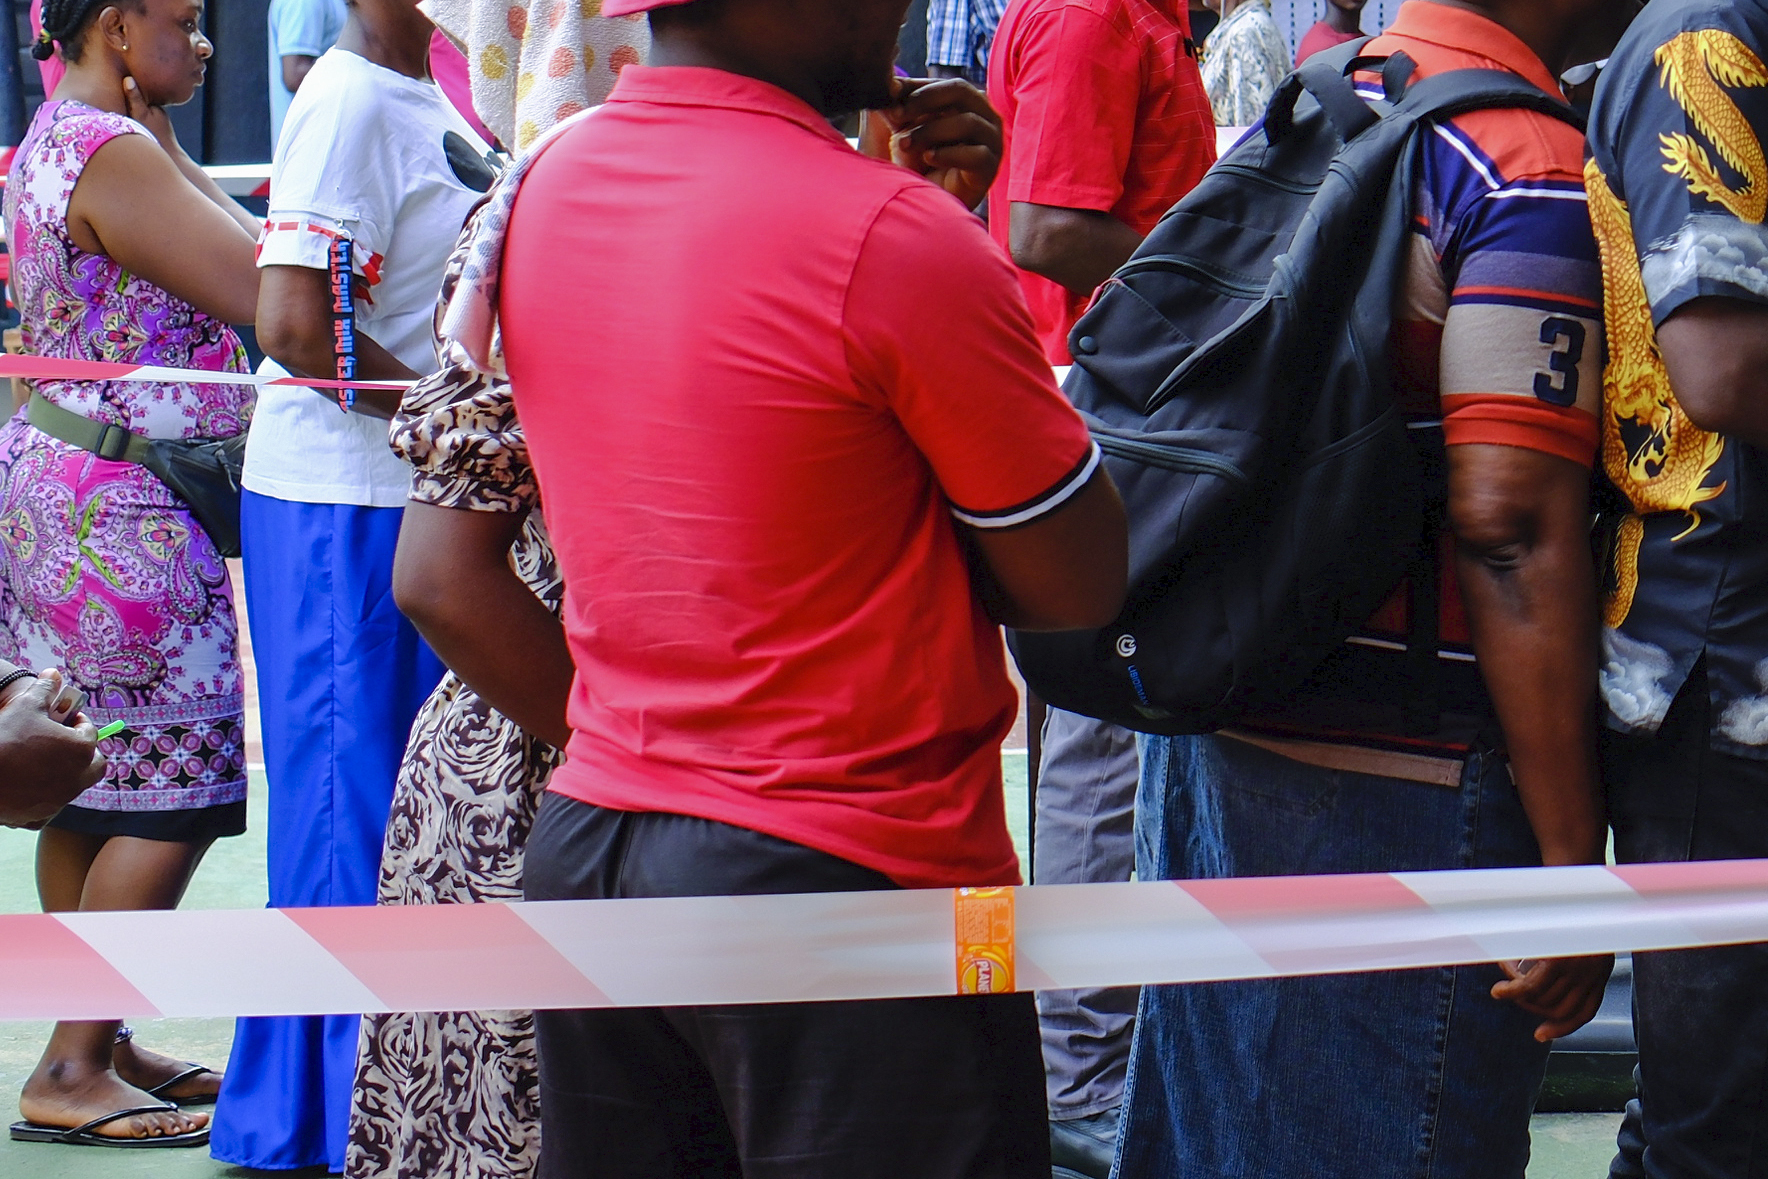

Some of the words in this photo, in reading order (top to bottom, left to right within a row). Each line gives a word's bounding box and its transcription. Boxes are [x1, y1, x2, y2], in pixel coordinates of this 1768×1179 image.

[330, 240, 354, 314] MASTER
[334, 318, 354, 354] MIX
[1532, 316, 1586, 408] 3
